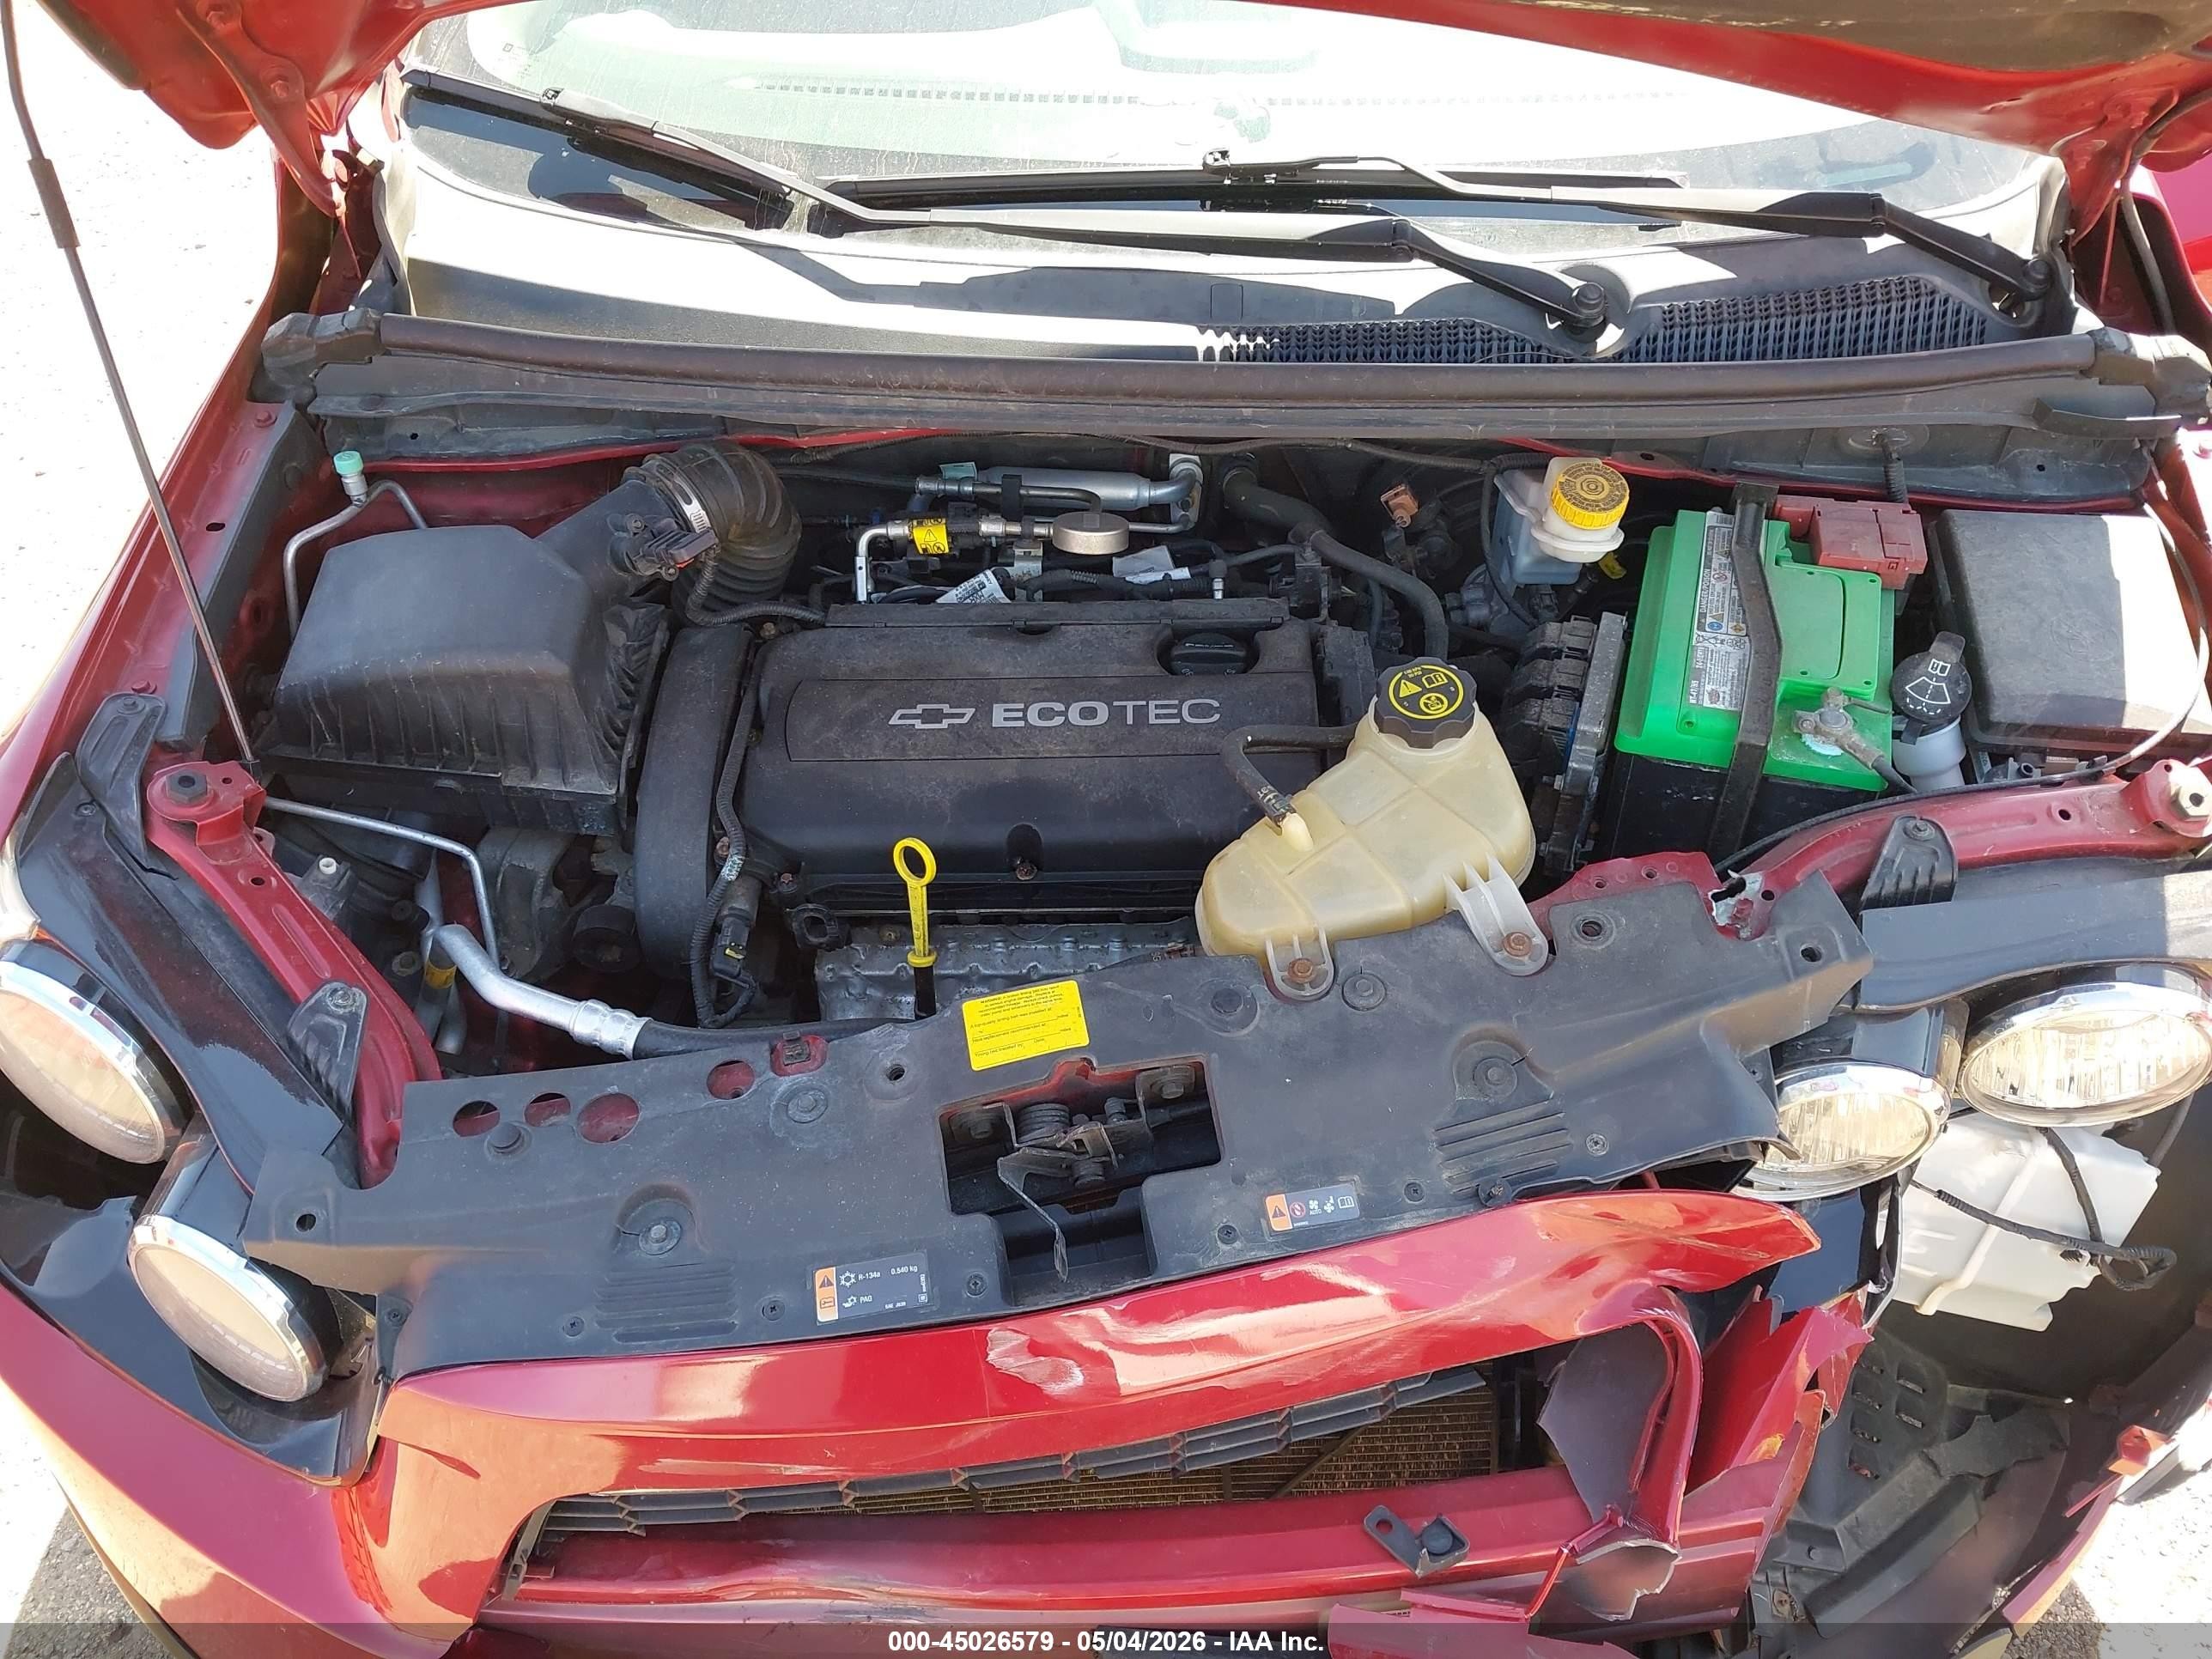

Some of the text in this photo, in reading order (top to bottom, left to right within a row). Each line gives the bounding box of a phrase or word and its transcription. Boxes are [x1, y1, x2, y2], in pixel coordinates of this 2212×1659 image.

[1699, 568, 1711, 612] DANGER/POISON
[992, 699, 1221, 727] ECOTEC
[858, 1271, 881, 1281] R-134a
